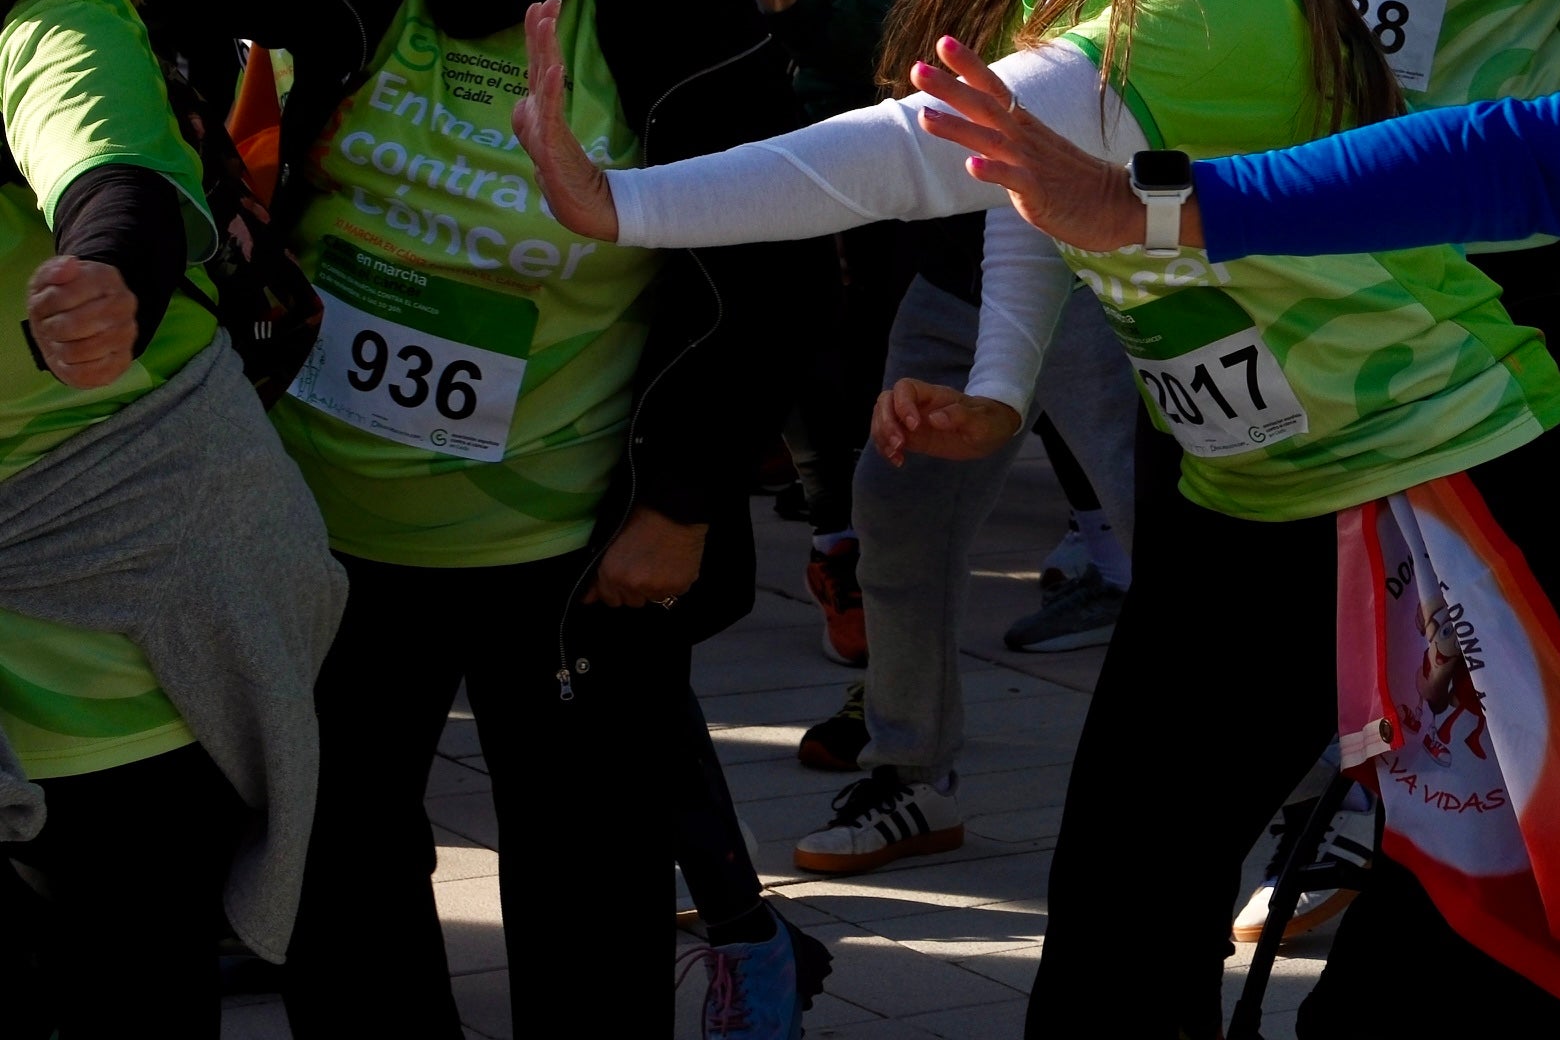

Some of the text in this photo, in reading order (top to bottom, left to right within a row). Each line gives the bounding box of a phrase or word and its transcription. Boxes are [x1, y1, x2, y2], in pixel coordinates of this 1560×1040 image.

[446, 50, 519, 79] asociación
[487, 75, 502, 89] el
[368, 71, 429, 126] En
[453, 86, 494, 105] Cádiz
[340, 131, 529, 213] contra
[352, 185, 598, 281] cáncer
[356, 252, 373, 268] en
[373, 259, 429, 287] marcha
[347, 329, 482, 420] 936
[1138, 344, 1267, 426] 2017
[1447, 602, 1486, 673] DONA
[1424, 785, 1506, 813] VIDAS
